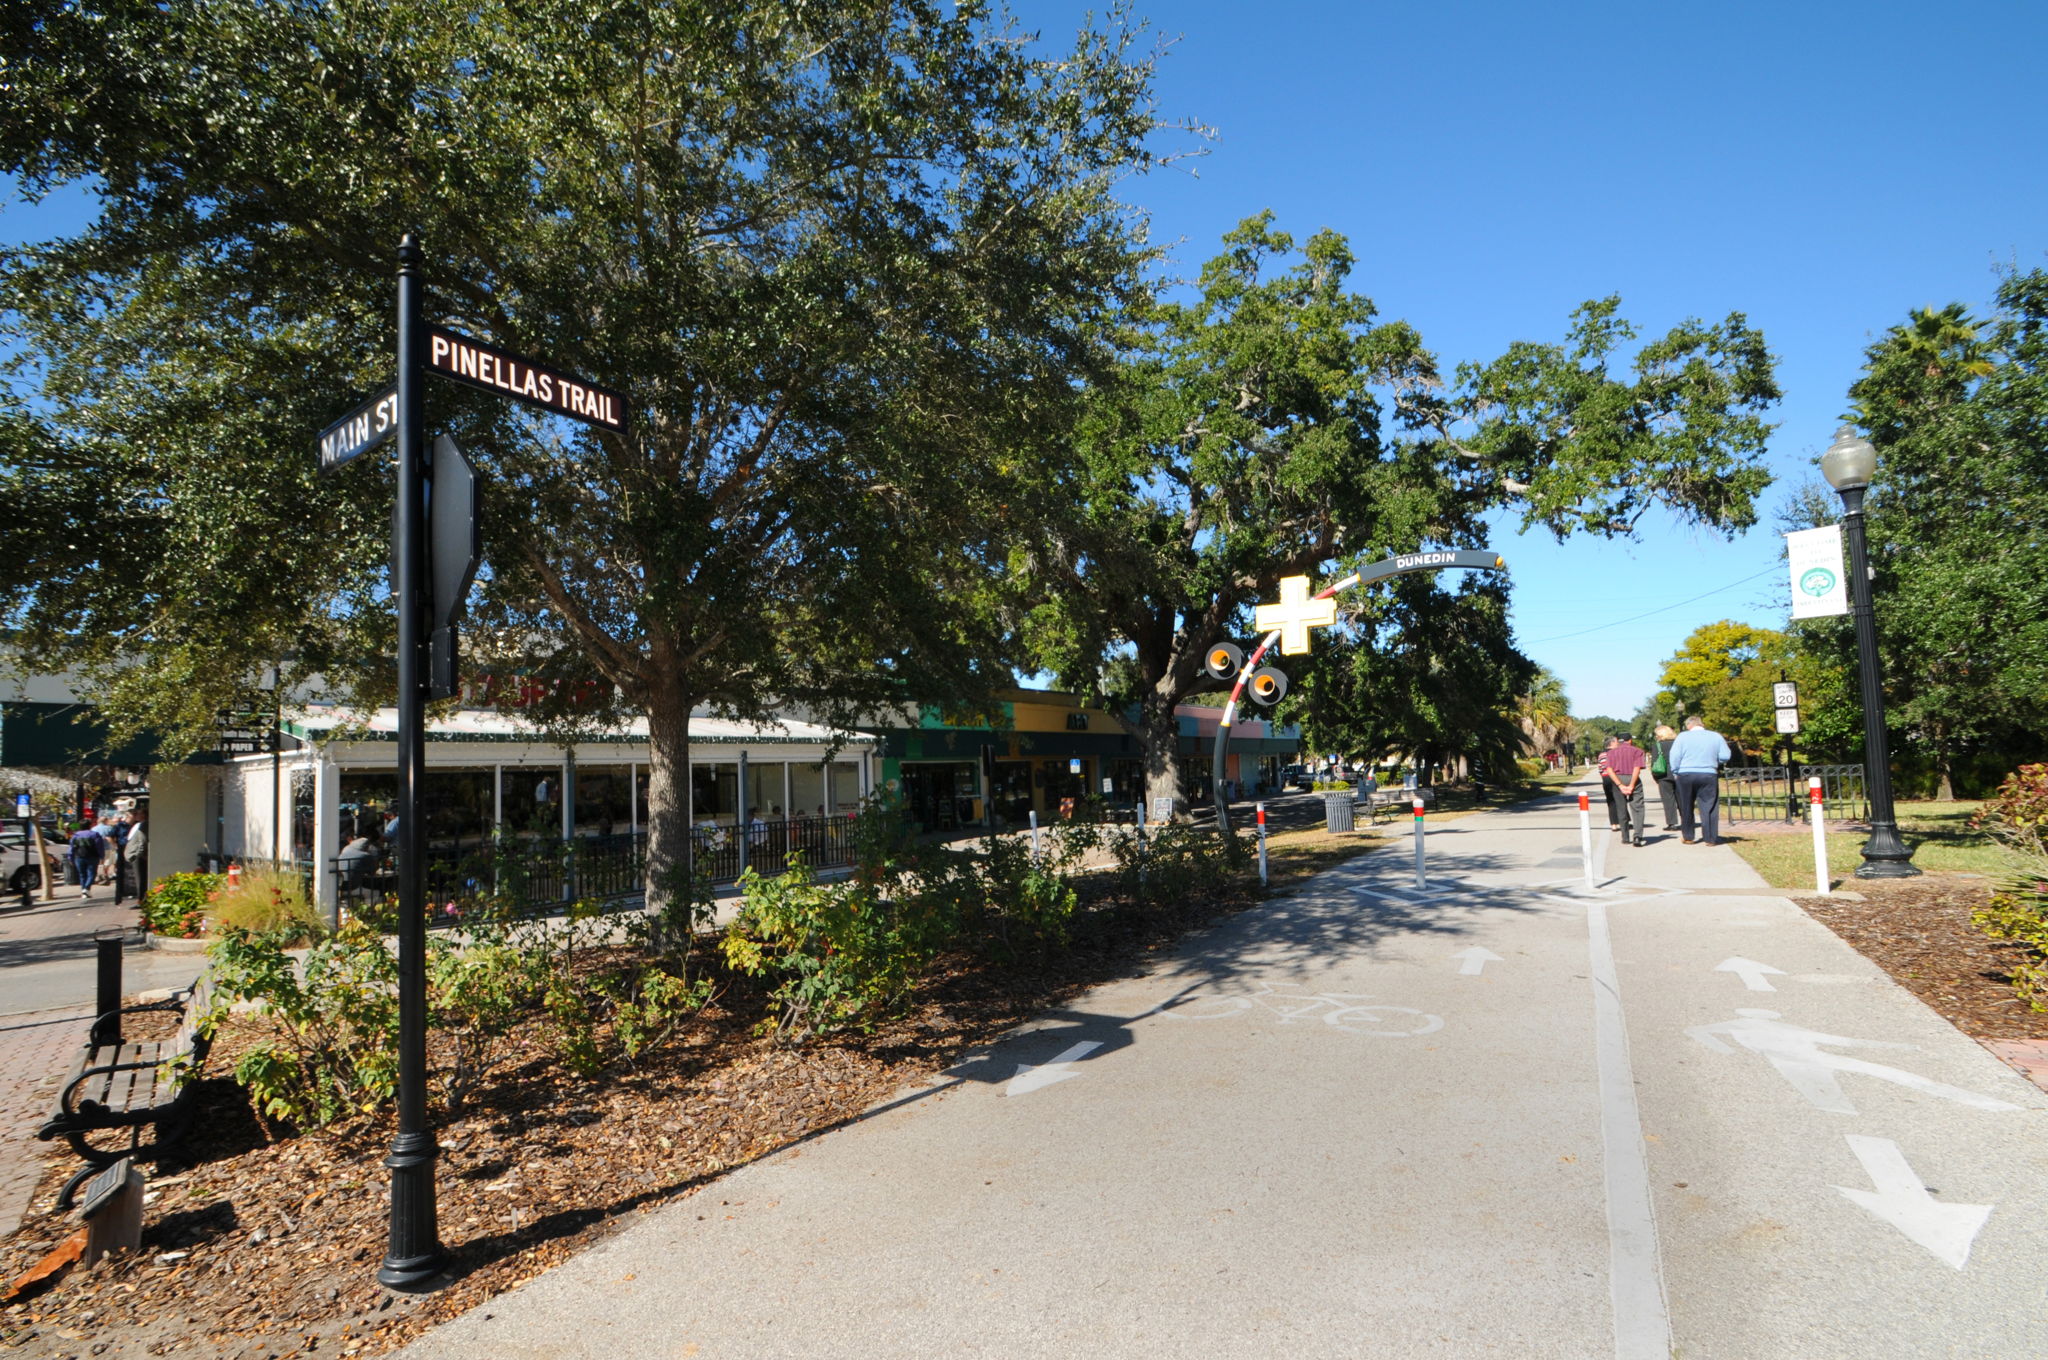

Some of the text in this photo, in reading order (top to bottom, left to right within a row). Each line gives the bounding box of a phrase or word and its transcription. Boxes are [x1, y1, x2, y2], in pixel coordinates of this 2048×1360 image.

[432, 335, 619, 425] PINELLAS TRAIL
[321, 412, 369, 467] MAIN
[1397, 553, 1455, 568] DUNEDIN
[1778, 695, 1793, 704] 20
[230, 743, 253, 751] PAPER
